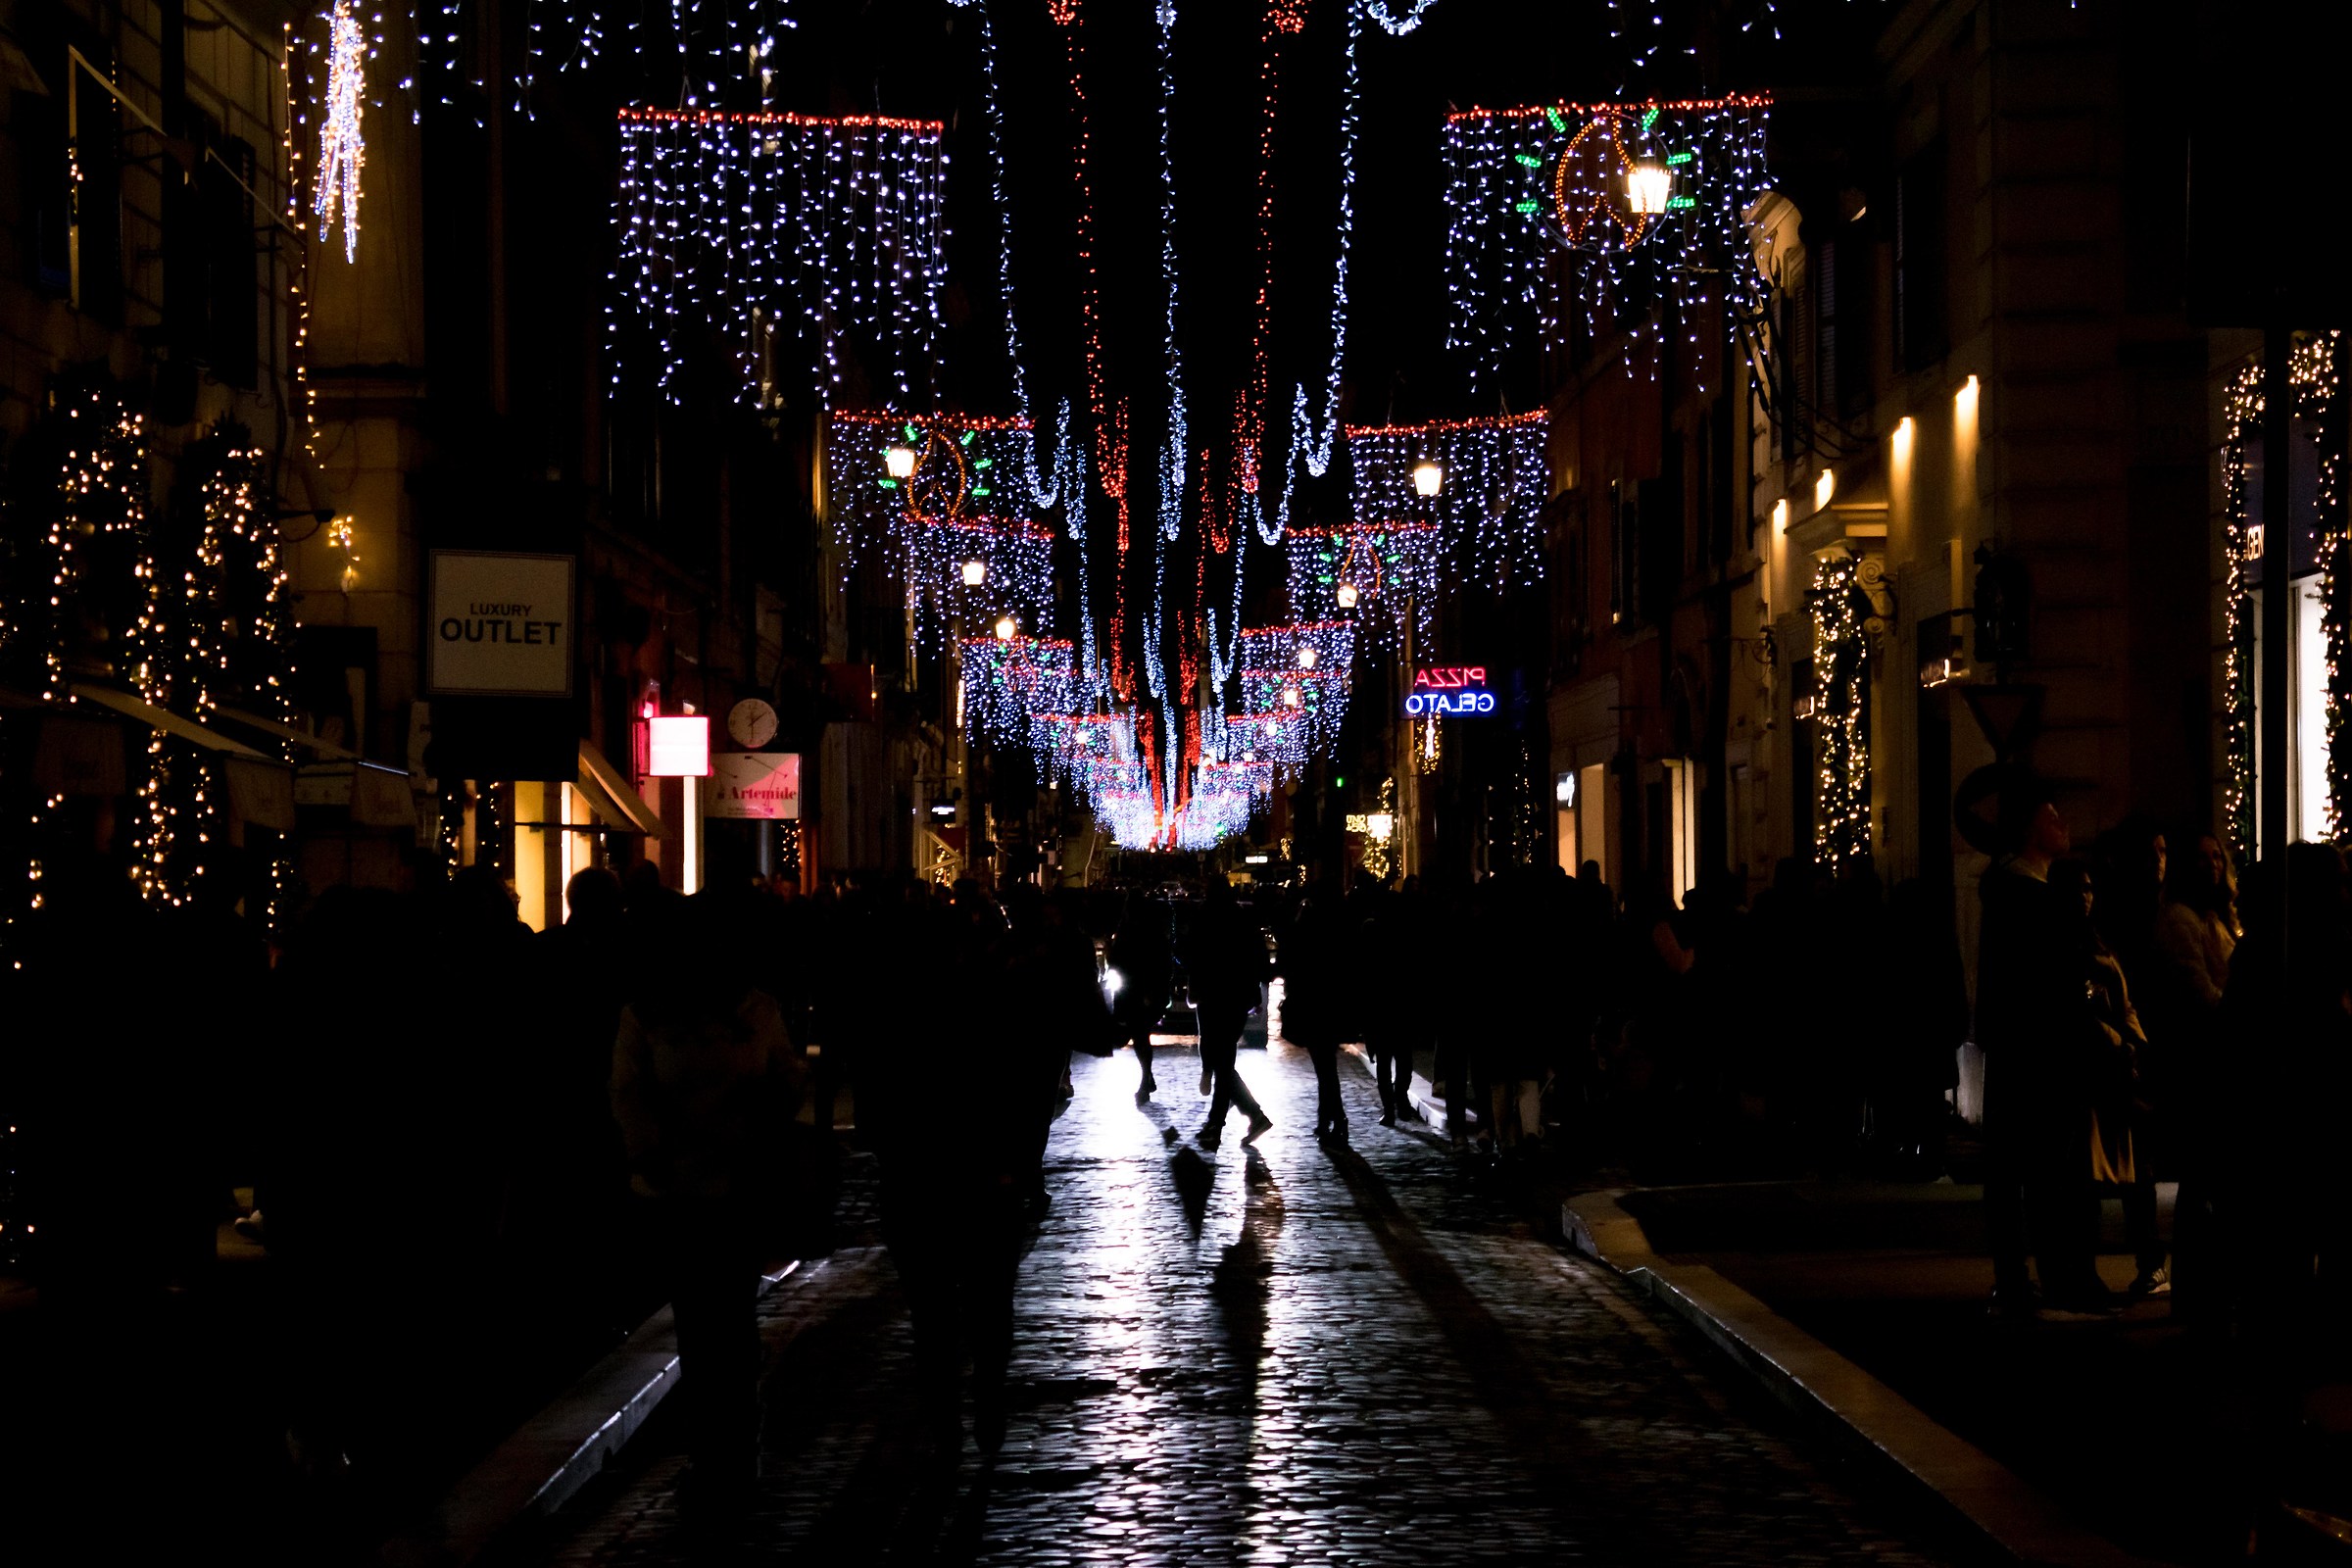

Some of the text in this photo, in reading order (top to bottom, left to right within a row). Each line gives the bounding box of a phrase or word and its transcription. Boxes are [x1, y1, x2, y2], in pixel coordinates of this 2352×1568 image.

[470, 602, 532, 616] LUXURY
[440, 617, 562, 645] OUTLET
[731, 786, 797, 800] Artemide
